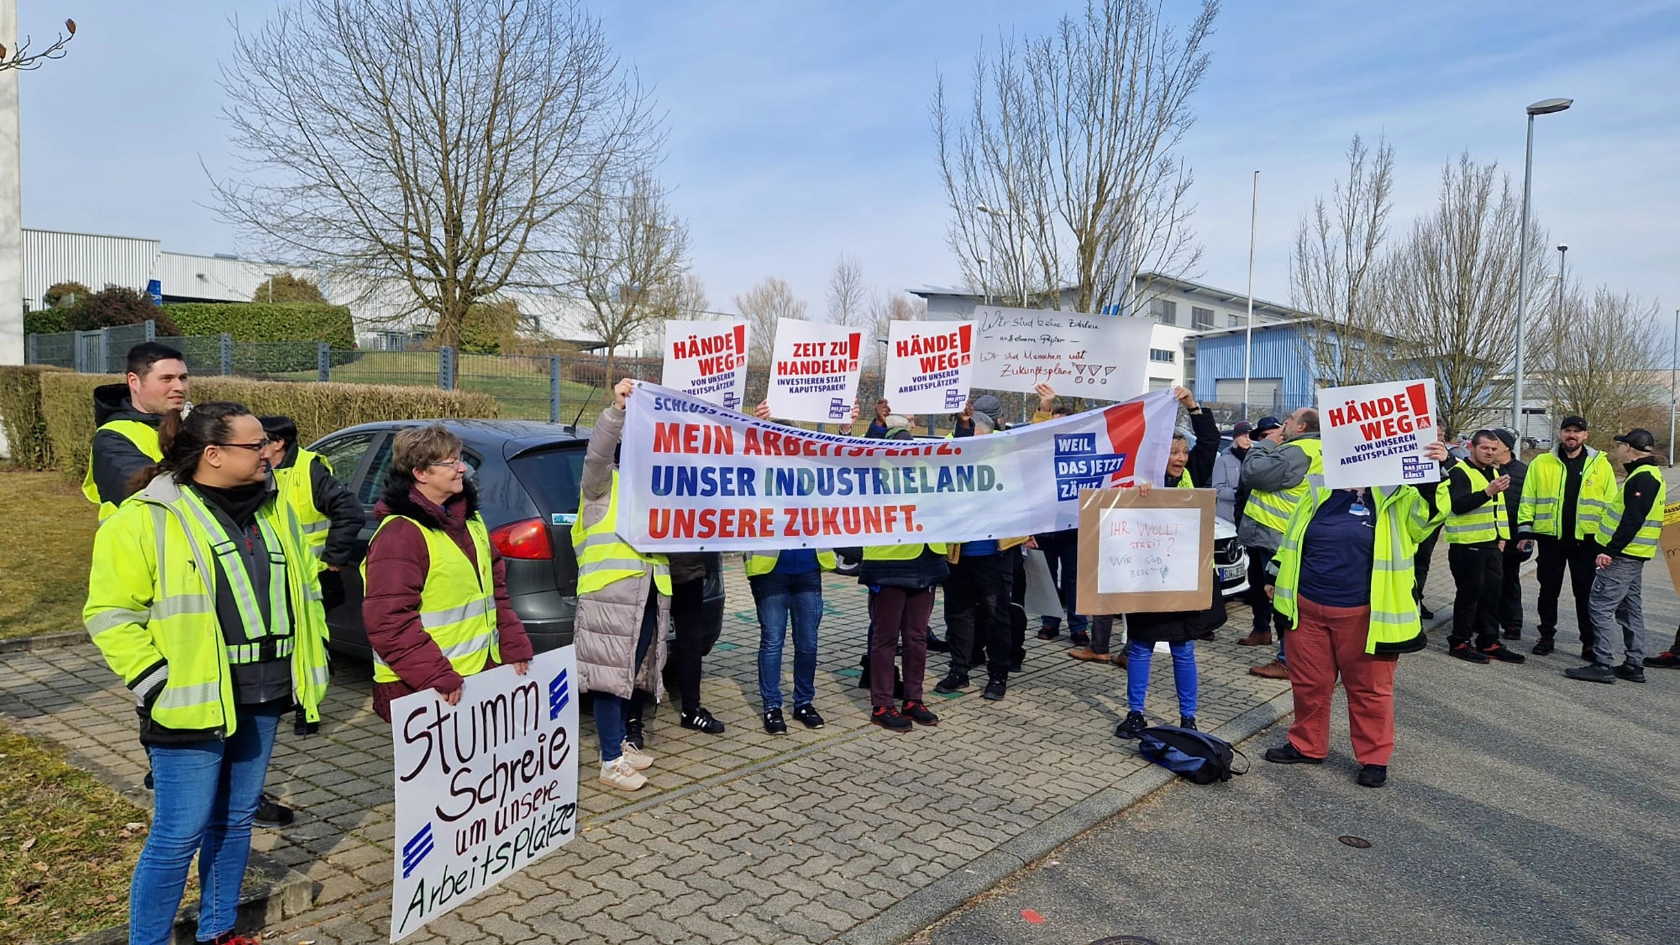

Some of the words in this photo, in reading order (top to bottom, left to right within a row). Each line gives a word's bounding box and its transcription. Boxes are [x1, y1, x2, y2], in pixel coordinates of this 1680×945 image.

[673, 332, 734, 360] HÄNDE
[793, 342, 826, 357] ZEIT
[896, 333, 959, 358] HÄNDE
[1040, 333, 1066, 347] Papier
[1024, 349, 1062, 360] Menschen
[690, 378, 707, 387] VON
[707, 371, 735, 384] UNSEREN
[777, 377, 825, 386] INVESTIEREN
[826, 375, 846, 383] STATT
[928, 369, 959, 381] UNSEREN
[789, 383, 846, 394] KAPUTTSPAREN!
[898, 377, 959, 394] ARBEITSPLÄTZEN!
[1328, 393, 1409, 428] HÄNDE
[653, 396, 717, 415] SCHLUSS
[751, 421, 846, 443] ABWICKLUNG
[849, 438, 876, 446] UND
[652, 422, 734, 455] MEIN
[1058, 438, 1092, 452] WEIL
[1354, 442, 1373, 453] VON
[1375, 434, 1416, 451] UNSEREN
[1340, 442, 1419, 465] ARBEITSPLÄTZEN!
[1058, 460, 1088, 475] DAS
[1089, 457, 1124, 476] JETZT
[1416, 463, 1432, 471] JETZT
[651, 465, 757, 497] UNSER
[764, 464, 1004, 497] INDUSTRIELAND.
[648, 508, 775, 539] UNSERE
[783, 504, 924, 537] ZUKUNFT.
[1110, 520, 1130, 537] IHR
[1136, 521, 1184, 537] WOLLT
[399, 680, 539, 783] Stumm
[435, 725, 571, 823] Schreie
[455, 817, 487, 856] um
[493, 779, 561, 837] unsere
